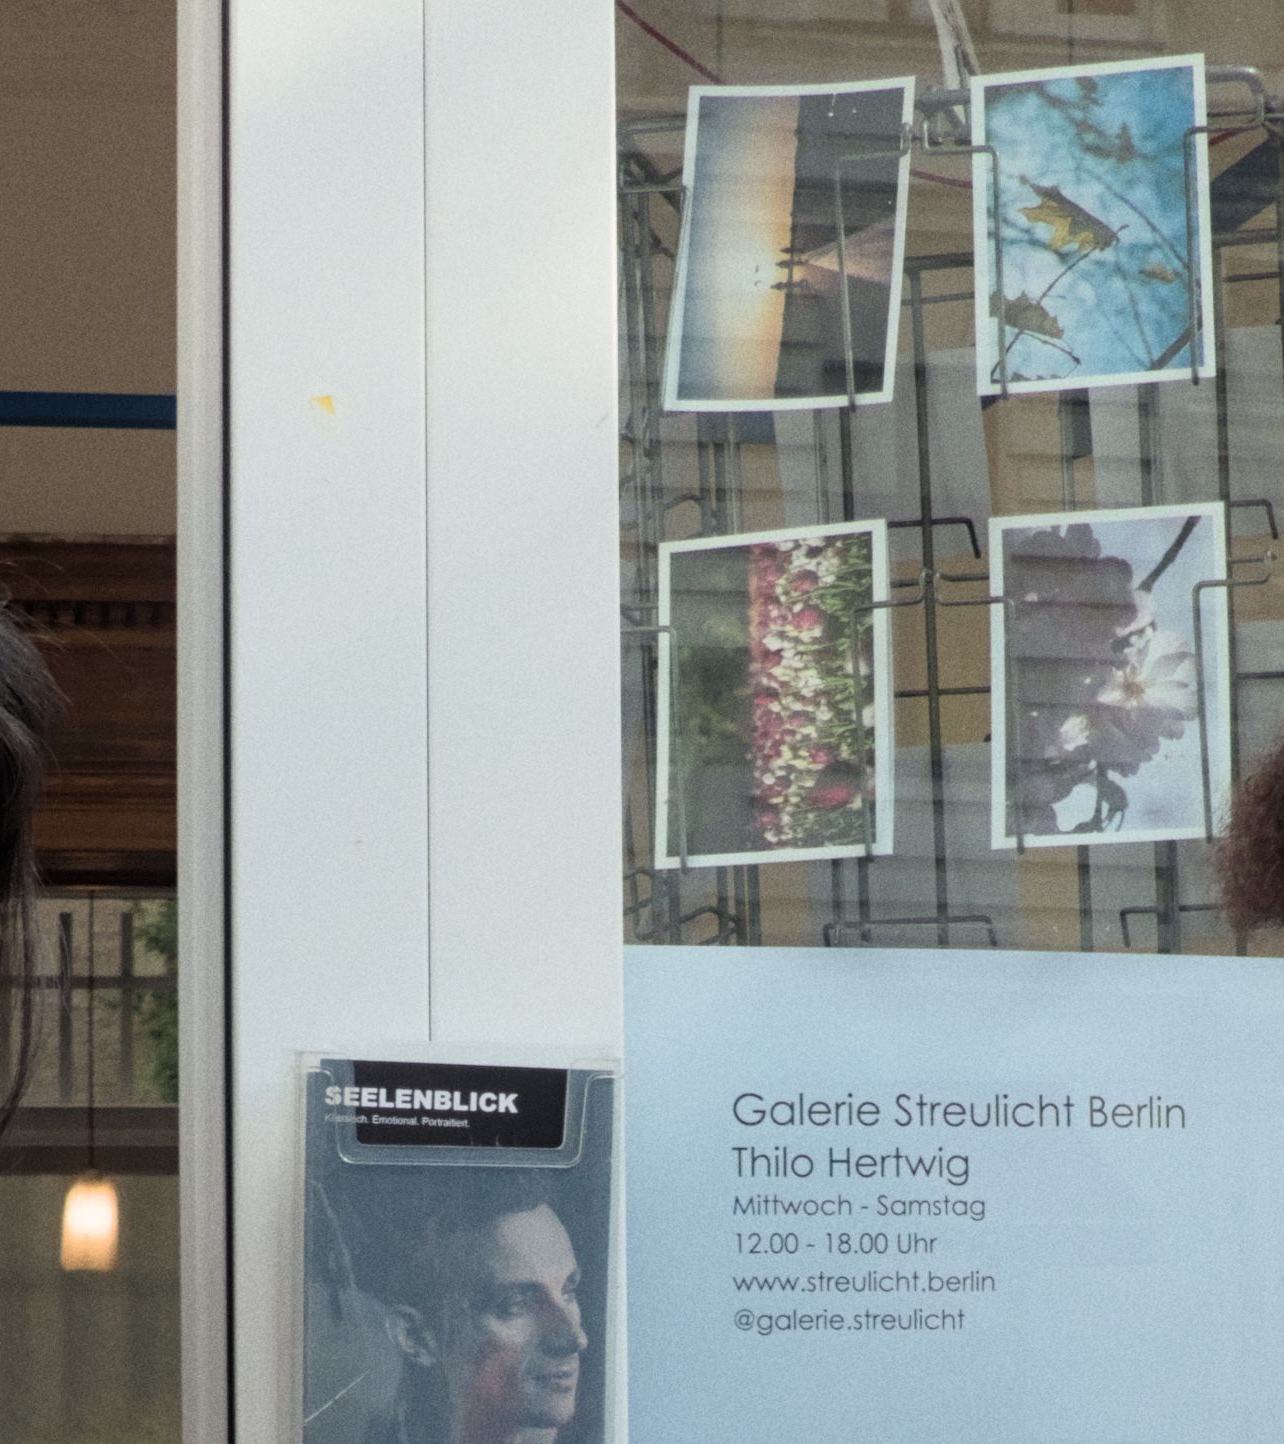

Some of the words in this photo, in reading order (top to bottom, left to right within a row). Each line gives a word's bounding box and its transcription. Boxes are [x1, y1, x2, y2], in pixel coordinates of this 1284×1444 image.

[324, 1085, 519, 1114] SEELENBLICK
[732, 1092, 881, 1127] Galerie
[894, 1093, 1074, 1128] Streulicht
[1089, 1095, 1186, 1129] Berlin
[372, 1114, 419, 1126] Emotional.
[731, 1146, 814, 1178] Thilo
[828, 1146, 970, 1186] Hertwig
[732, 1194, 853, 1216] Mittwoch
[876, 1194, 986, 1222] Samstag
[735, 1232, 799, 1254] 12.00
[826, 1232, 889, 1254] 18.00
[897, 1232, 938, 1254] Uhr
[732, 1271, 996, 1293] www.streulicht.berlin
[734, 1307, 965, 1336] @galerie.streulicht
